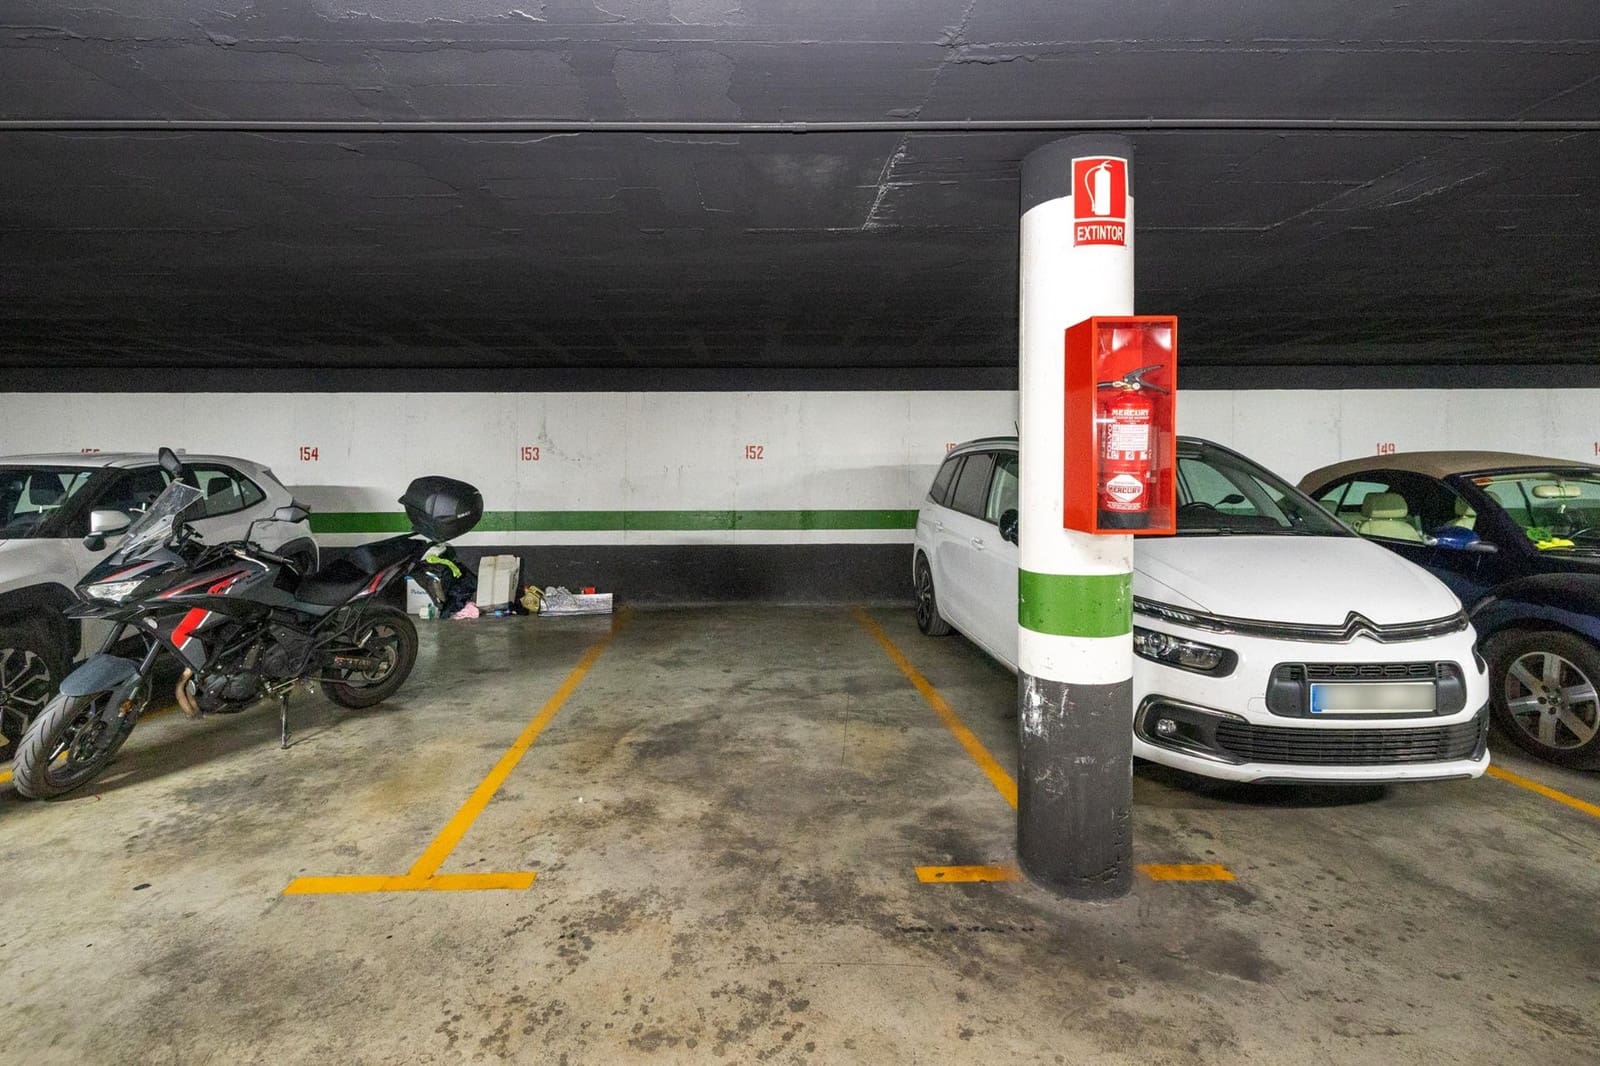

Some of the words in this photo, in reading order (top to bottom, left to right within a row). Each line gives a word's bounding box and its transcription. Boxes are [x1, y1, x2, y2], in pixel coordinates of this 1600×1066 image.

[1077, 225, 1123, 241] EXTINTOR
[1112, 409, 1149, 417] MERCURY
[300, 447, 318, 461] 154
[521, 447, 539, 461] 153
[746, 446, 763, 459] 152
[1377, 443, 1395, 456] 149
